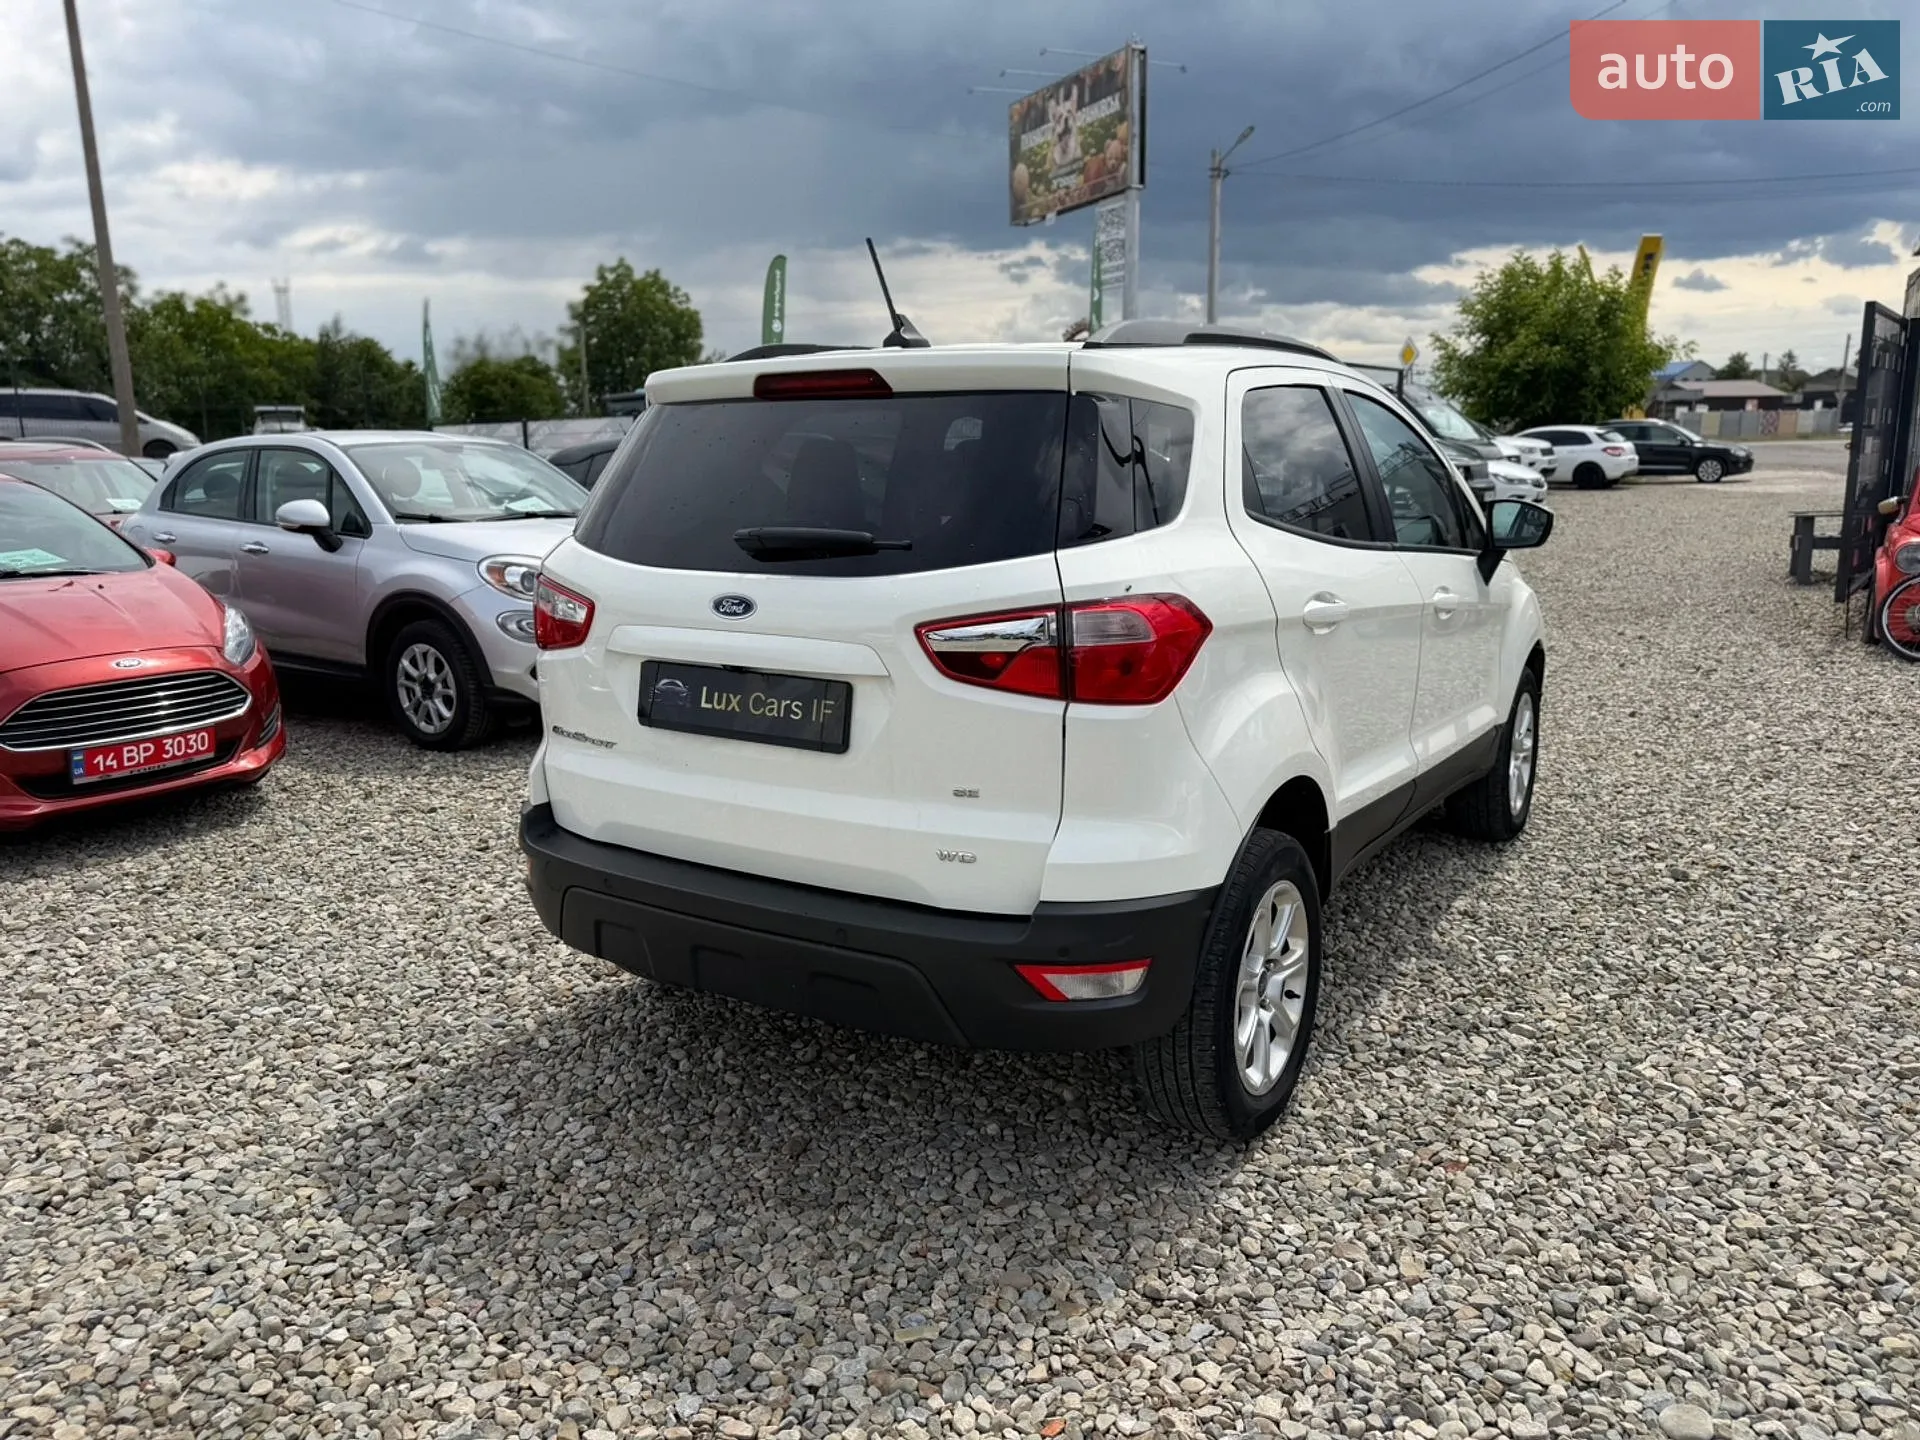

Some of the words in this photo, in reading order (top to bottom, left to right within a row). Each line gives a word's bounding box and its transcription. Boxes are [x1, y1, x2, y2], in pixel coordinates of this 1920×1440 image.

[719, 598, 746, 613] Ford
[700, 686, 742, 712] Lux
[749, 692, 803, 720] Cars
[811, 698, 836, 723] IF
[92, 752, 118, 772] 14
[122, 743, 155, 767] BP
[162, 731, 209, 759] 3030
